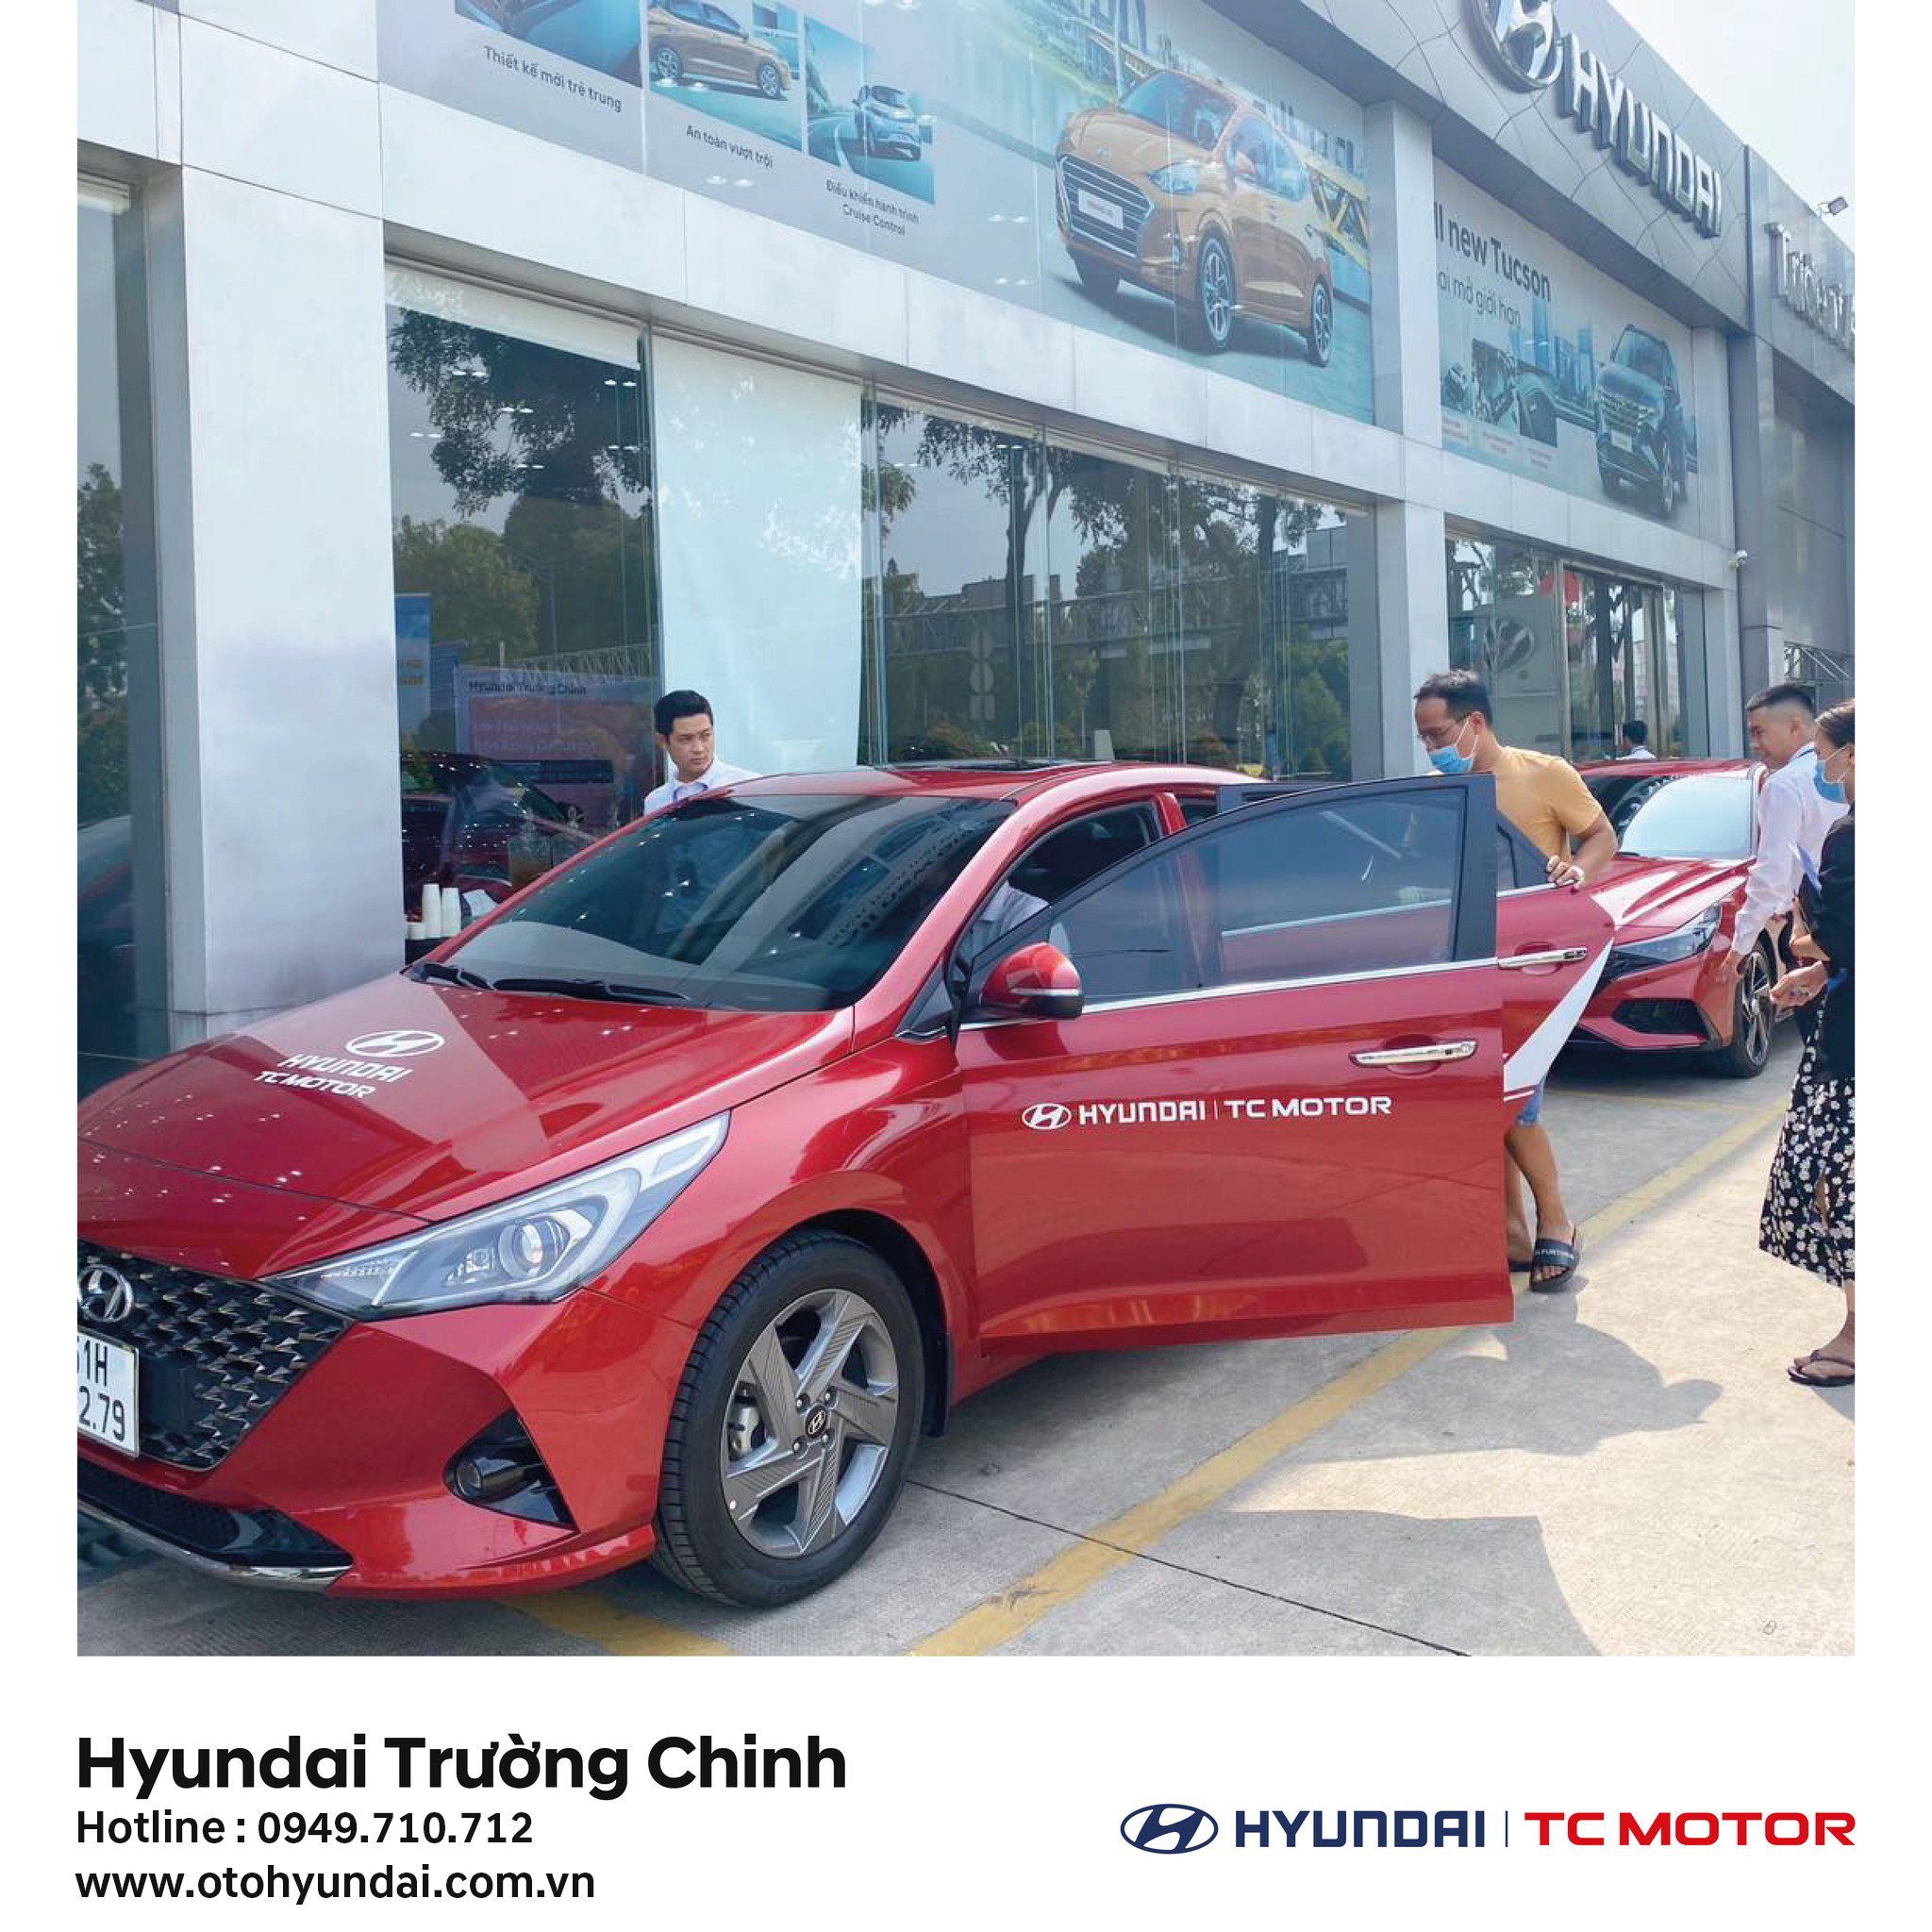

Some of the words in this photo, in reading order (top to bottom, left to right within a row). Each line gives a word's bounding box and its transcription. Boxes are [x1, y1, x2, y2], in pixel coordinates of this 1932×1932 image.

[484, 45, 519, 70] Thiết
[589, 88, 623, 112] trung
[687, 125, 701, 141] An
[1559, 32, 1722, 238] HYUNDAI
[1434, 201, 1443, 242] ll
[1448, 219, 1488, 267] new
[1491, 237, 1551, 303] Tucson
[1438, 270, 1450, 293] ai
[276, 1054, 413, 1083] HYUNDAI
[254, 1070, 284, 1084] TC
[279, 1073, 376, 1098] MOTOR
[1079, 1100, 1206, 1125] HYUNDAI
[1223, 1098, 1266, 1119] TC
[1272, 1095, 1392, 1119] MOTOR
[77, 1336, 108, 1387] 1H
